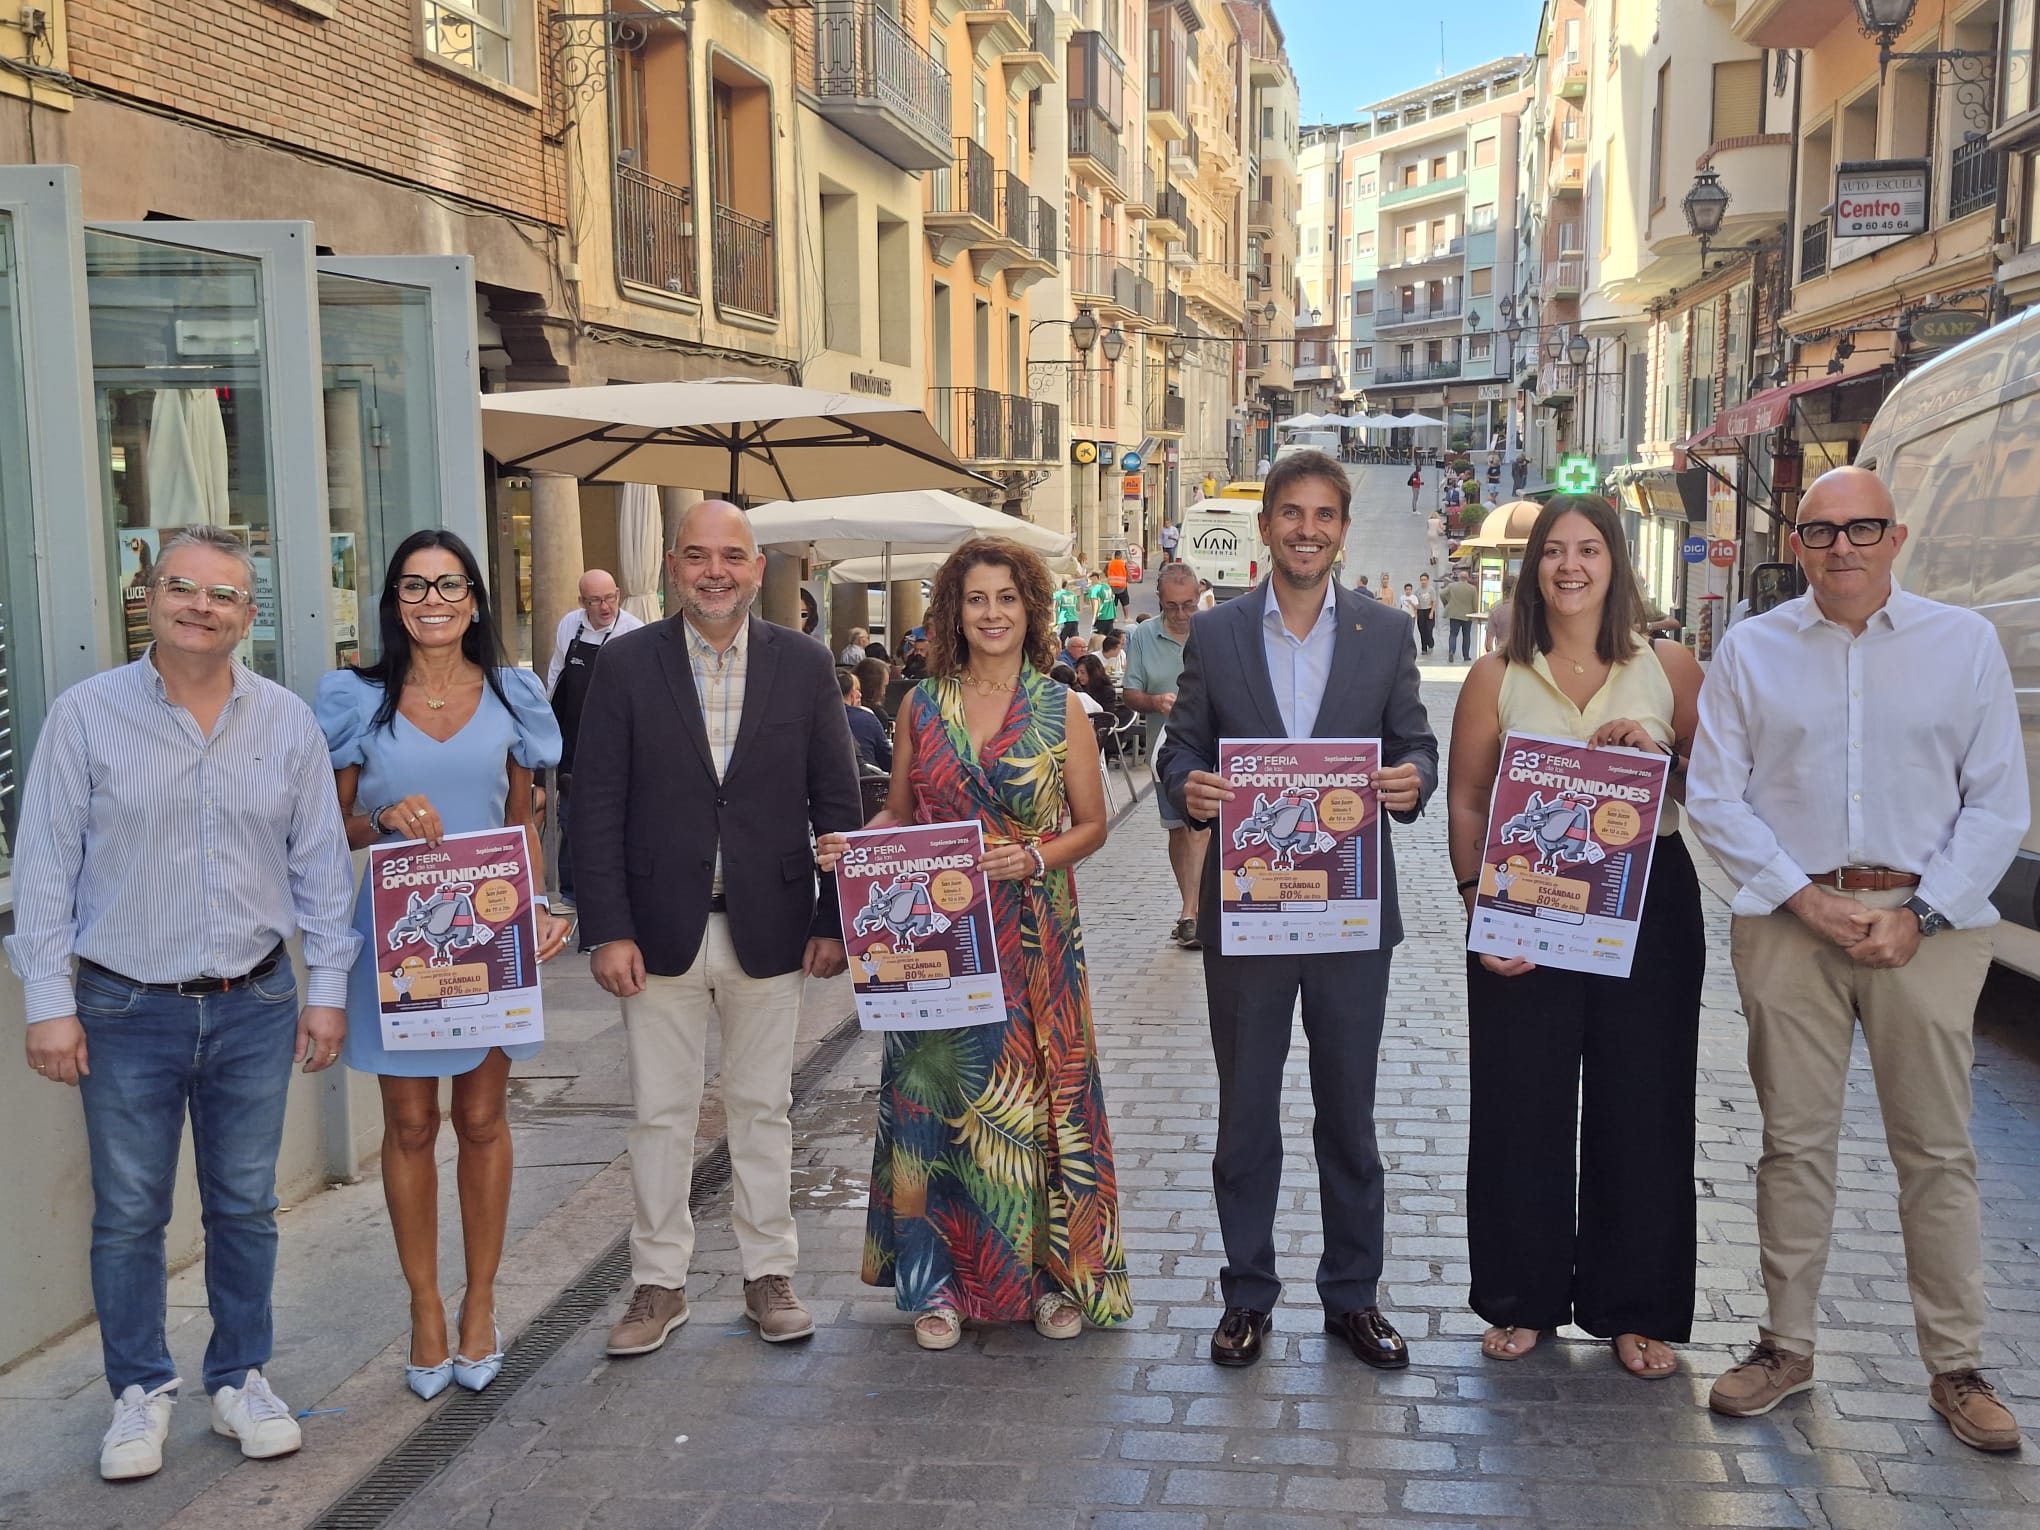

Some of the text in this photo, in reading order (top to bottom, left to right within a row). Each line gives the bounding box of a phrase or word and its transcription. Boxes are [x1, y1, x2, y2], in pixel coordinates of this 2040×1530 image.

[1840, 200, 1901, 218] Centro
[1866, 222, 1878, 230] 60
[1896, 220, 1909, 228] 64
[1924, 322, 1976, 336] SANZ
[1193, 537, 1237, 550] VIANI
[1684, 544, 1704, 552] DIGI
[1710, 544, 1734, 556] ria
[1264, 756, 1298, 766] FERIA
[1546, 755, 1581, 770] FERIA
[1230, 774, 1369, 788] OPORTUNIDADES
[1508, 768, 1650, 803] OPORTUNIDADES
[873, 844, 906, 855] FERIA
[416, 852, 451, 864] FERIA
[844, 854, 974, 878] OPORTUNIDADES
[382, 862, 520, 890] OPORTUNIDADES
[1280, 890, 1302, 900] 80%
[1538, 886, 1581, 900] ESCÁNDALO
[1536, 894, 1560, 908] 80%
[904, 962, 942, 970] ESCÁNDALO
[440, 976, 481, 986] ESCÁNDALO
[905, 970, 926, 980] 80%
[440, 986, 462, 996] 80%
